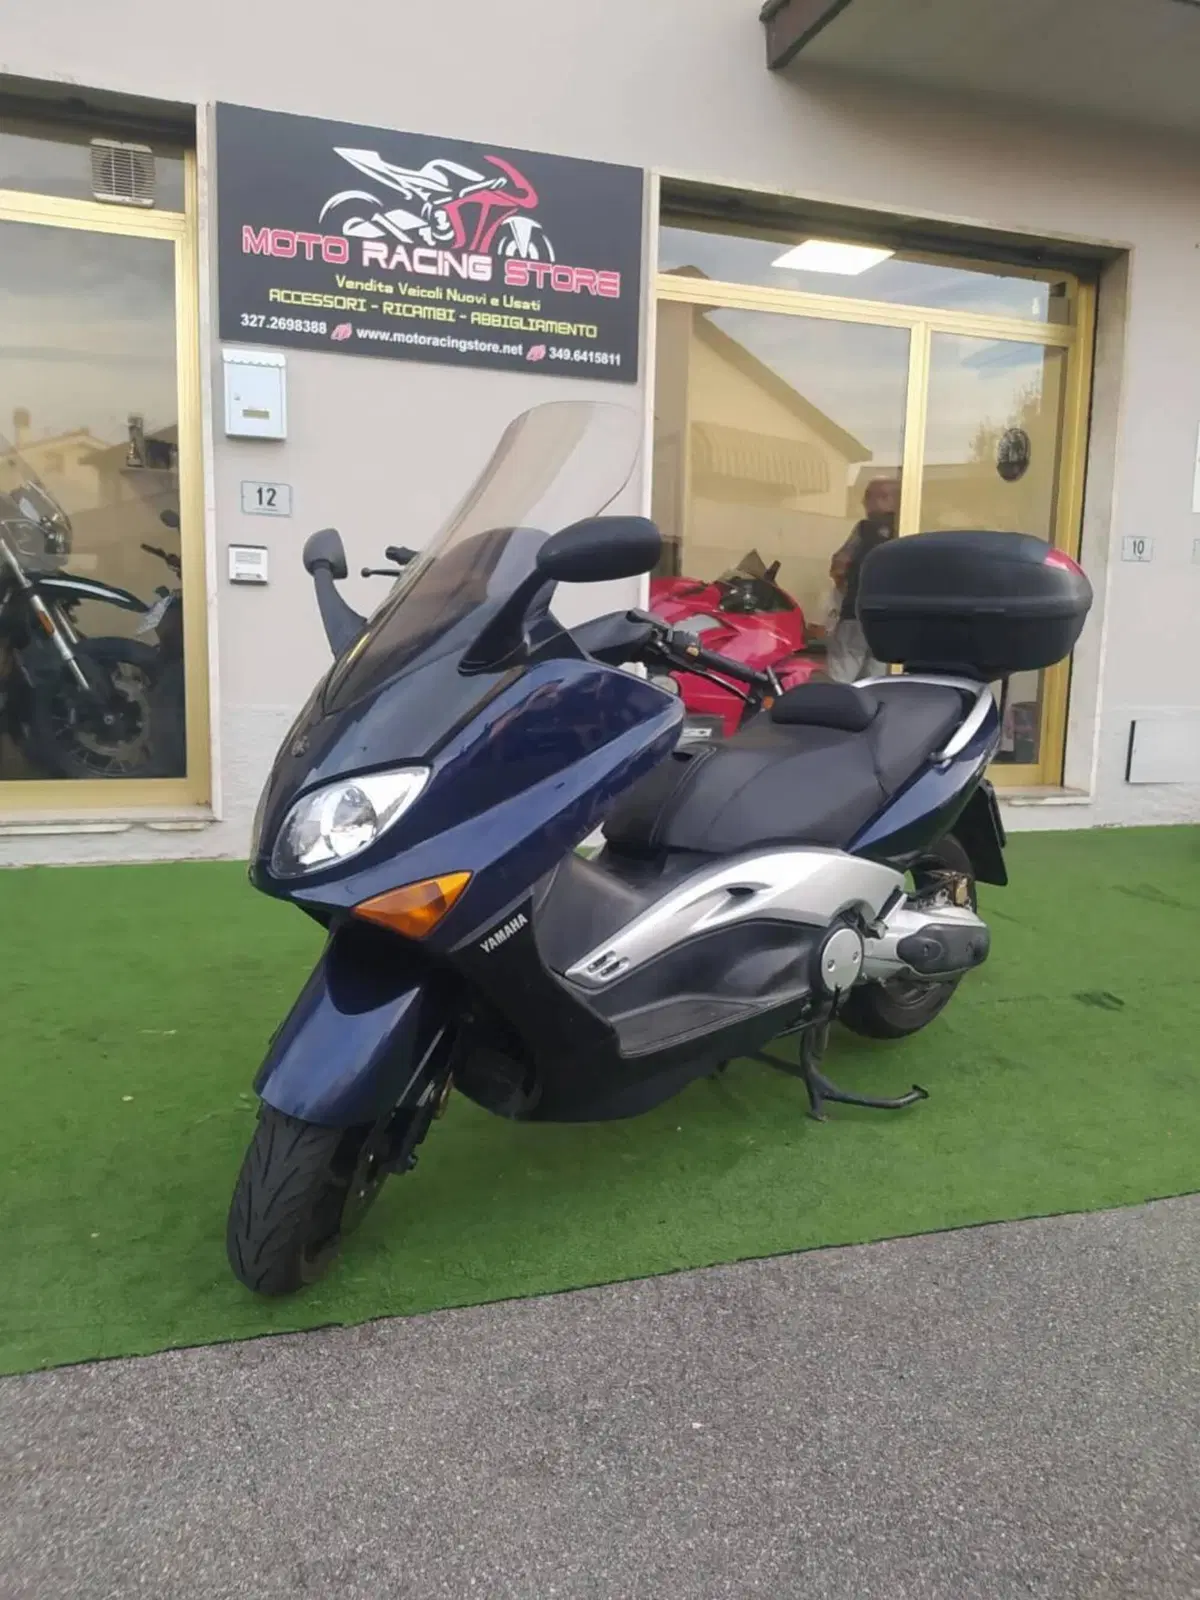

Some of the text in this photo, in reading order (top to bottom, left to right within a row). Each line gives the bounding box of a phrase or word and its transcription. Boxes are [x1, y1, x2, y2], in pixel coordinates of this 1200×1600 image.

[242, 225, 621, 298] MOTO RACING STORE
[335, 274, 541, 311] Vendita Veicoli Nuovi e Usati
[269, 288, 367, 312] ACCESSORI
[382, 301, 456, 323] RICAMBI
[470, 311, 598, 338] ABBIGLIAMENTO
[240, 313, 621, 366] 327.2698388 www.motoracingstore.net 349.6415811
[256, 486, 277, 507] 12
[1132, 539, 1145, 555] 10
[480, 913, 528, 953] YAMAHA
